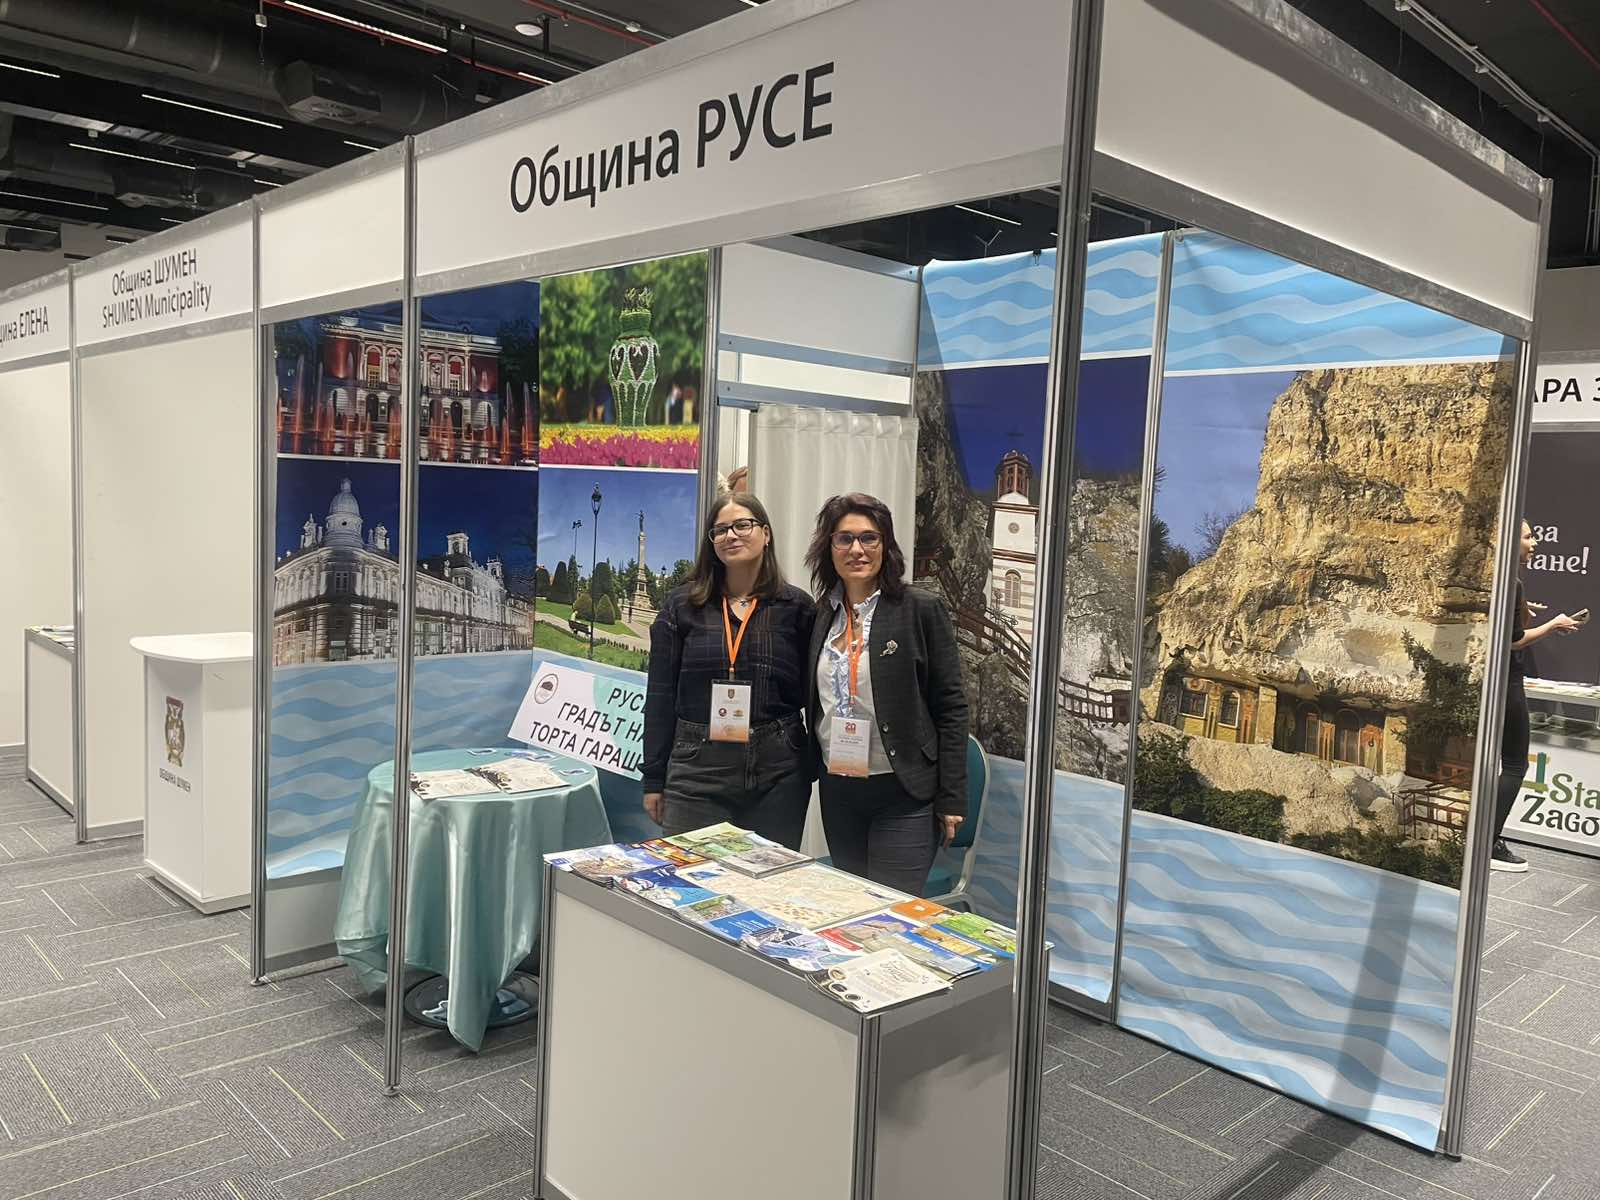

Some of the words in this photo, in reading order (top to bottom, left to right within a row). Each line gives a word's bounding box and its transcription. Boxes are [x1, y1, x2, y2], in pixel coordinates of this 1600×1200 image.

[510, 129, 680, 213] Община
[697, 61, 835, 168] РУСЕ
[112, 269, 152, 296] Община
[154, 248, 197, 284] ШУМЕН
[103, 296, 143, 328] SHUMEN
[145, 280, 212, 317] Municipality
[19, 306, 49, 338] ЕЛЕНА
[1533, 378, 1582, 403] РА
[607, 687, 646, 714] РУС
[557, 702, 626, 735] ГРАДЪТ
[530, 721, 577, 752] ТОРТА
